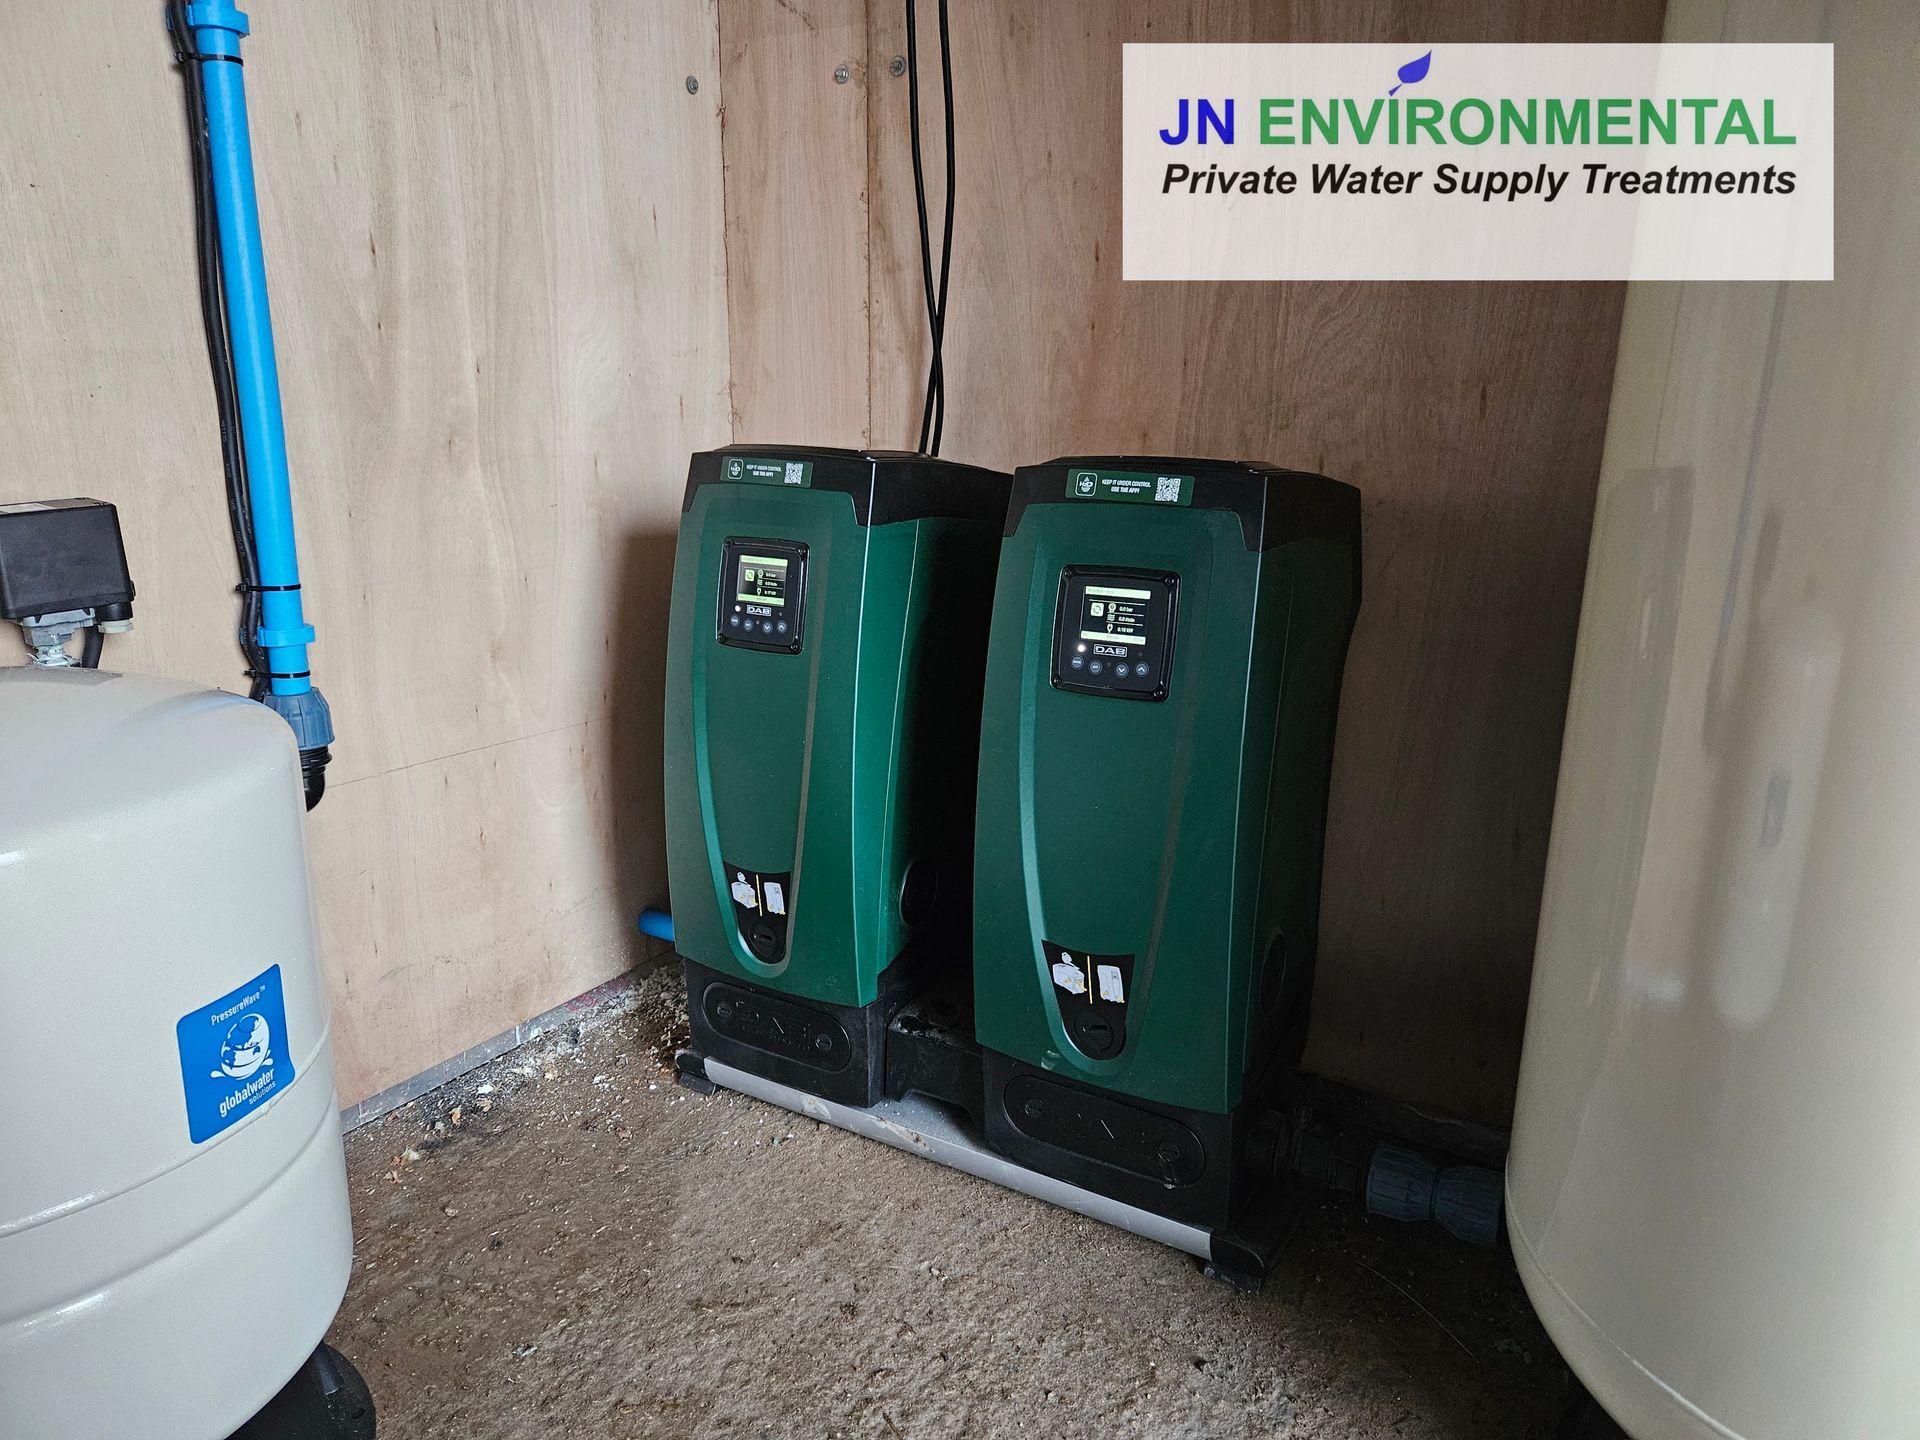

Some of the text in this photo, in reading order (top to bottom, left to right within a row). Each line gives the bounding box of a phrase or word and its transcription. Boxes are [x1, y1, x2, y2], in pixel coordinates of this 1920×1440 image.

[748, 606, 770, 615] DAB
[1095, 645, 1126, 656] DAB
[211, 991, 260, 1026] PressureWave
[219, 1068, 275, 1118] globalwater
[249, 1081, 276, 1105] solutions
